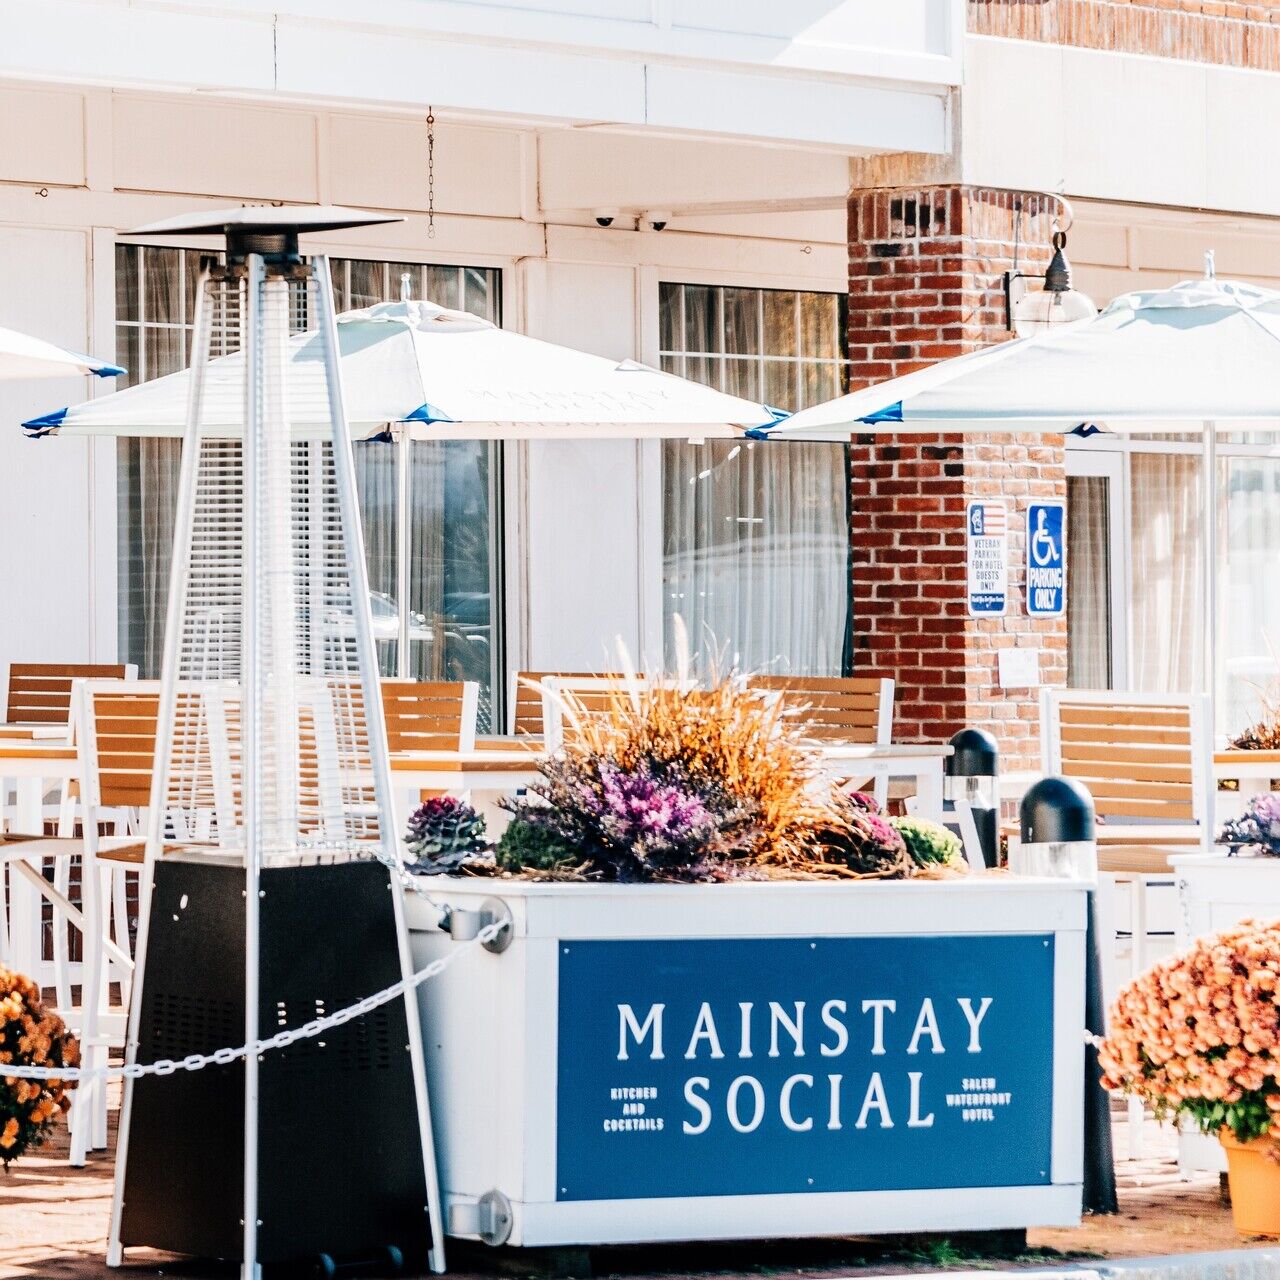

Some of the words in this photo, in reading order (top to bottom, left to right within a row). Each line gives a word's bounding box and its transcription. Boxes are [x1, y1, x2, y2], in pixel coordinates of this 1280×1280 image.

[974, 539, 1001, 549] VETERAN
[974, 550, 1001, 559] PARKING
[972, 560, 984, 570] FOR
[985, 560, 1004, 570] HOTEL
[975, 571, 1000, 580] GUESTS
[1029, 568, 1062, 588] PARKING
[980, 581, 995, 591] ONLY
[1034, 588, 1057, 609] ONLY
[616, 997, 993, 1061] MAINSTAY
[962, 1077, 996, 1091] SALEM
[610, 1086, 658, 1101] KITCHEN
[945, 1092, 1012, 1107] WATERFRONT
[622, 1102, 646, 1116] AND
[682, 1071, 935, 1135] SOCIAL
[962, 1108, 995, 1122] HOTEL
[603, 1118, 664, 1132] COCKTAILS
